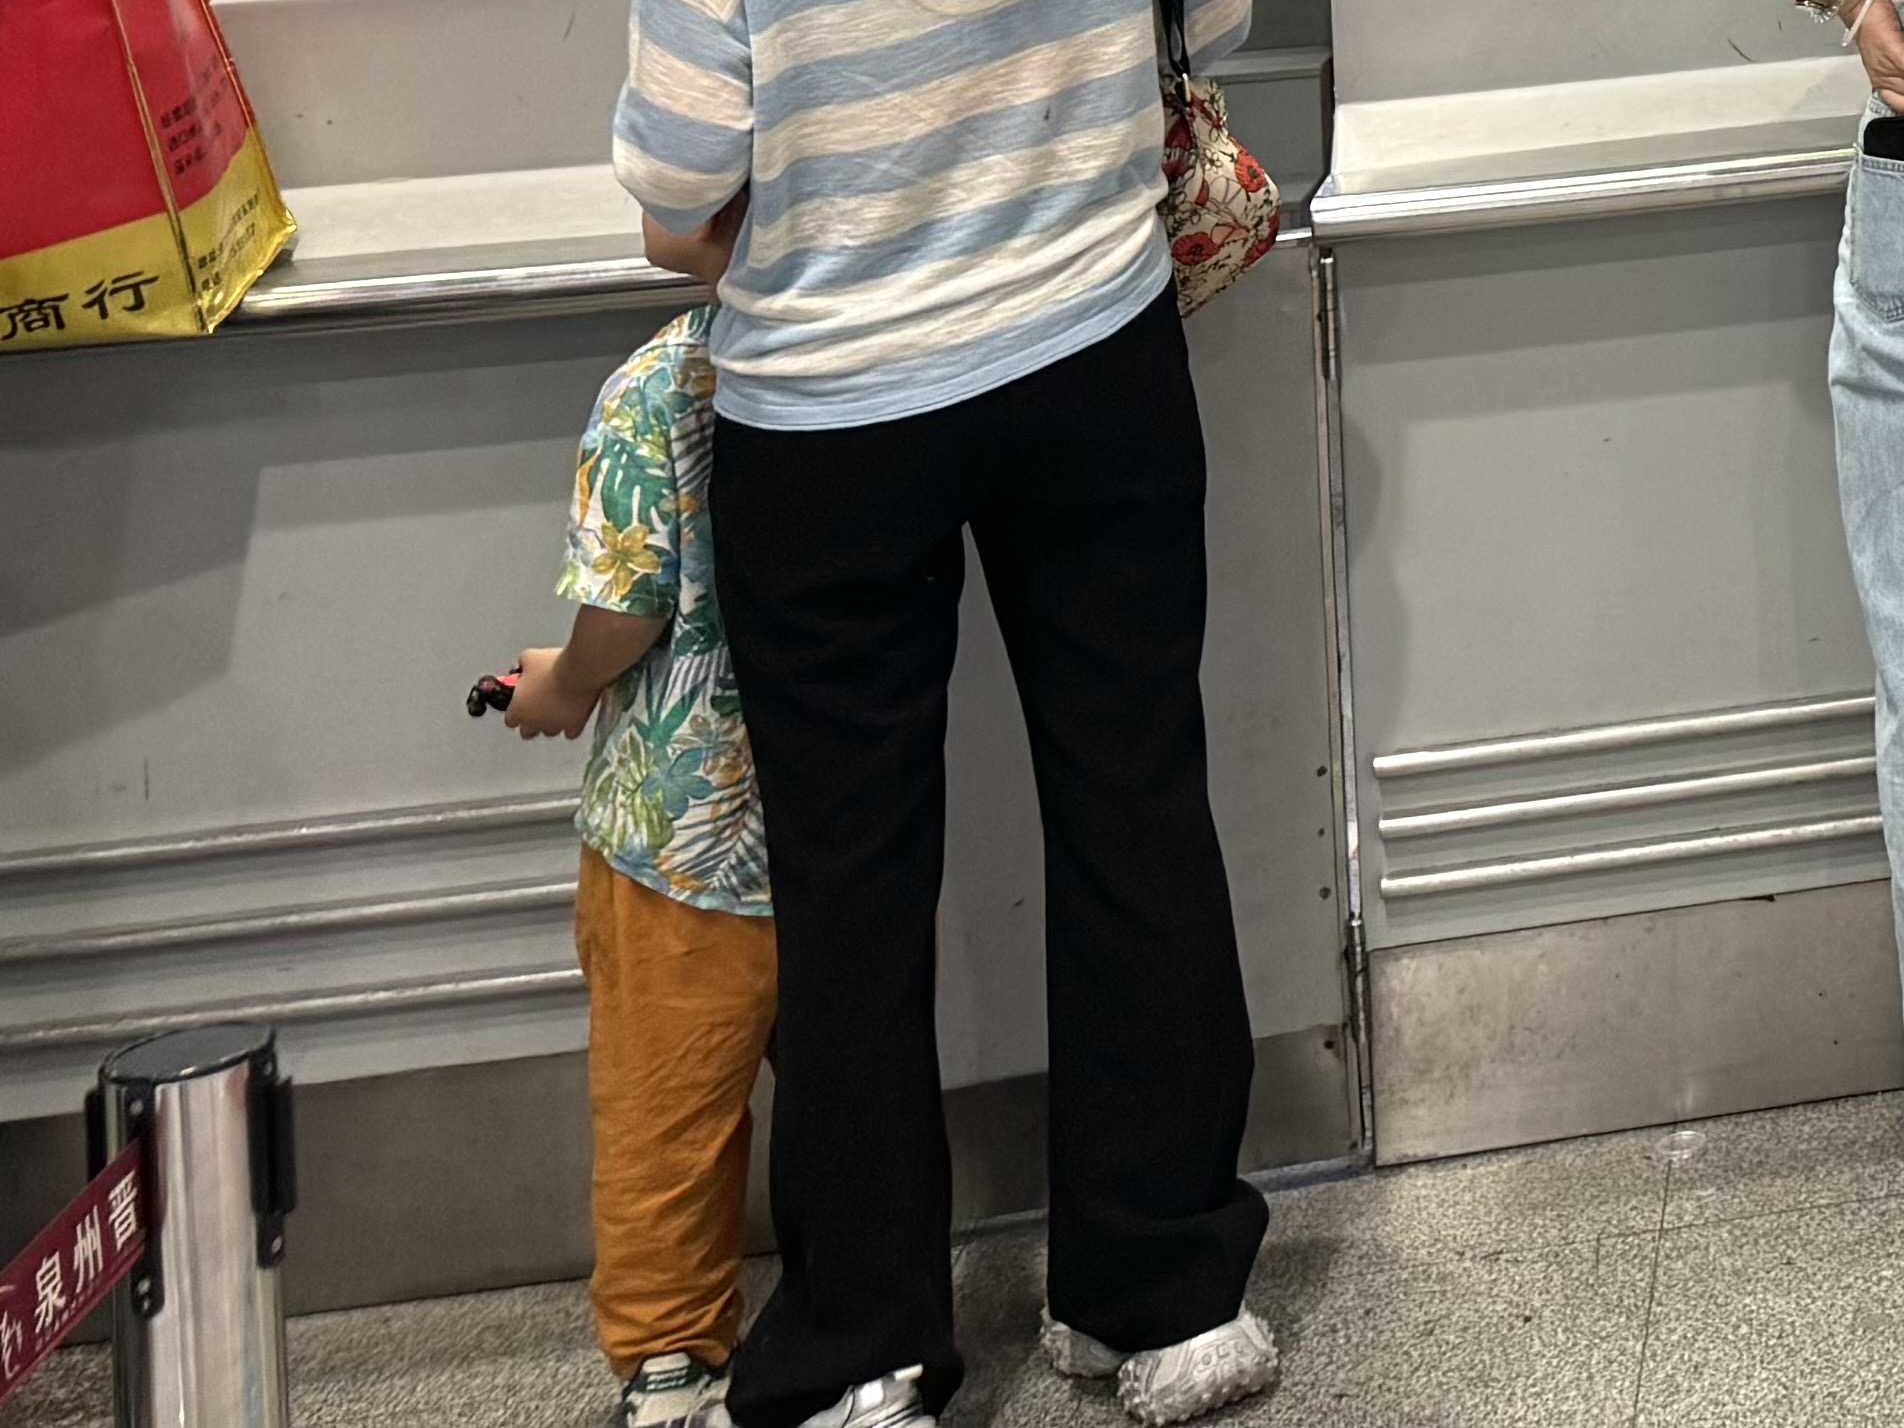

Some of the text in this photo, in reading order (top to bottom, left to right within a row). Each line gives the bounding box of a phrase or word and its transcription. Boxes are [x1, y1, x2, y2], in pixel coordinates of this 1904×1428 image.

[0, 270, 159, 339] 商行
[35, 1170, 138, 1333] 泉州晋
